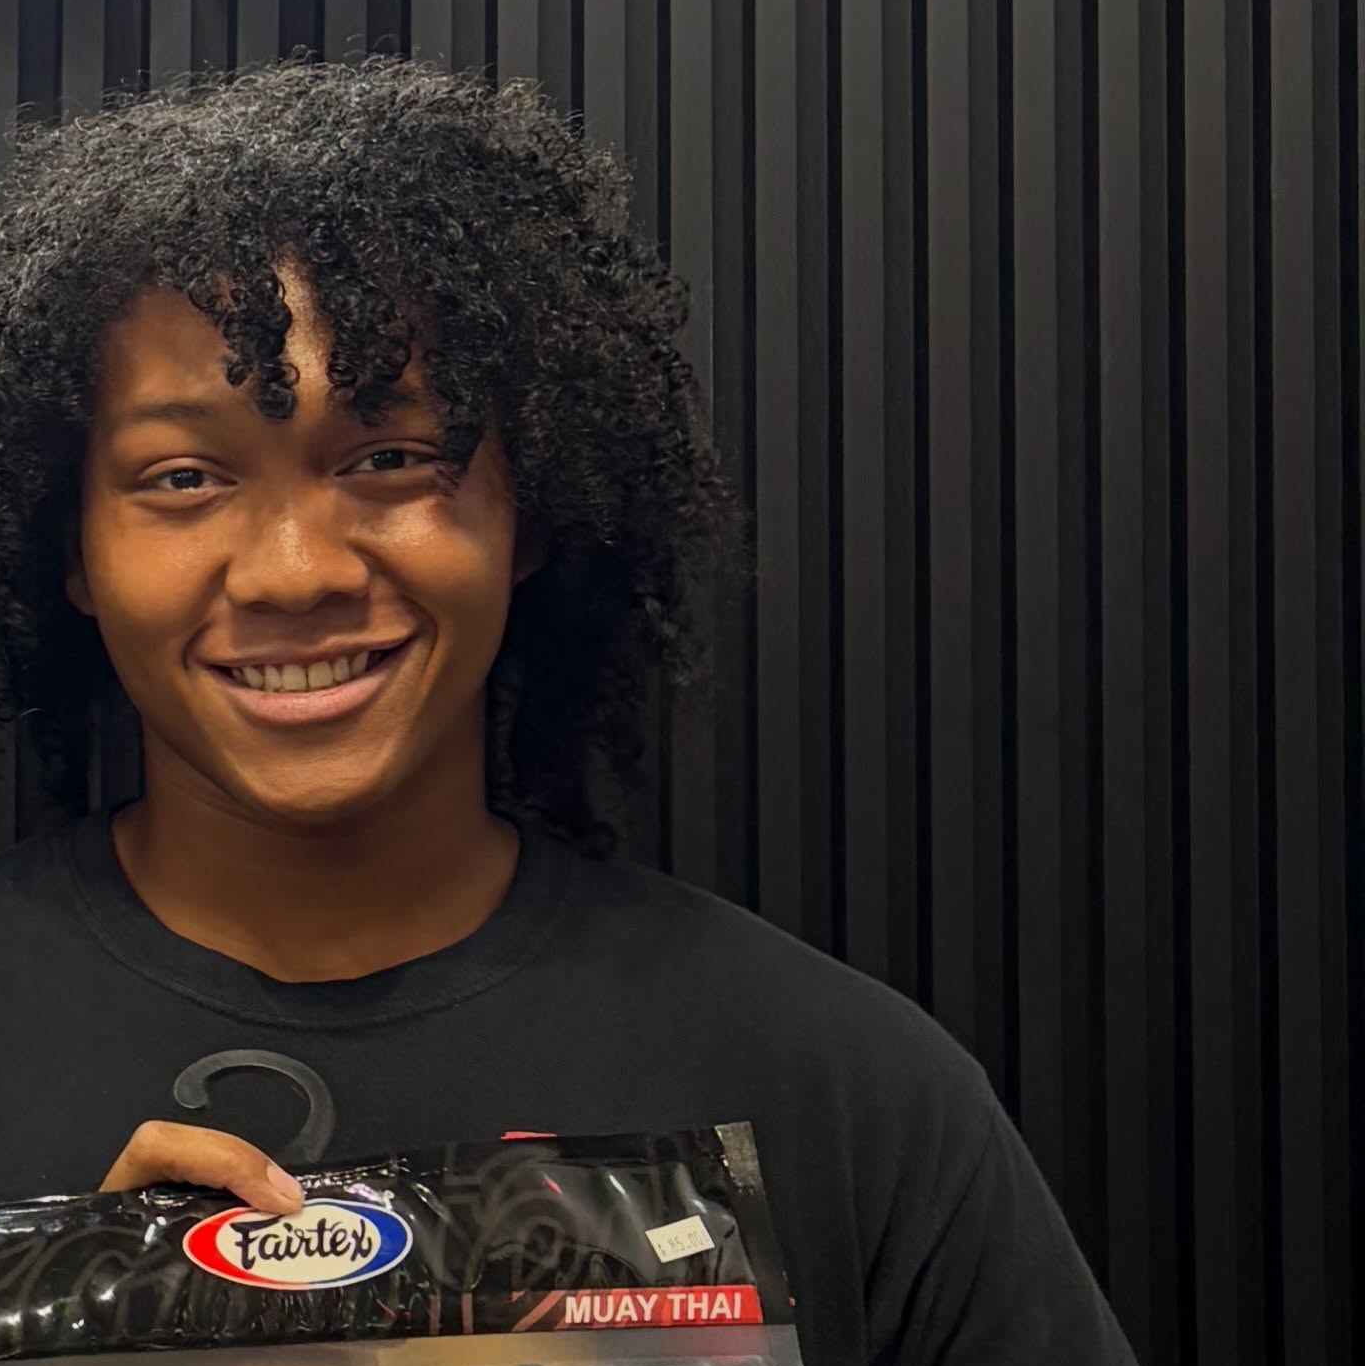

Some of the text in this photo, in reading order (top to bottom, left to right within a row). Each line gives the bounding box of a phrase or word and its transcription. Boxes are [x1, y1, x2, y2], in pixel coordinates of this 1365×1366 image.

[229, 1213, 373, 1271] Fairtex
[564, 1291, 742, 1324] MUAY THAI
